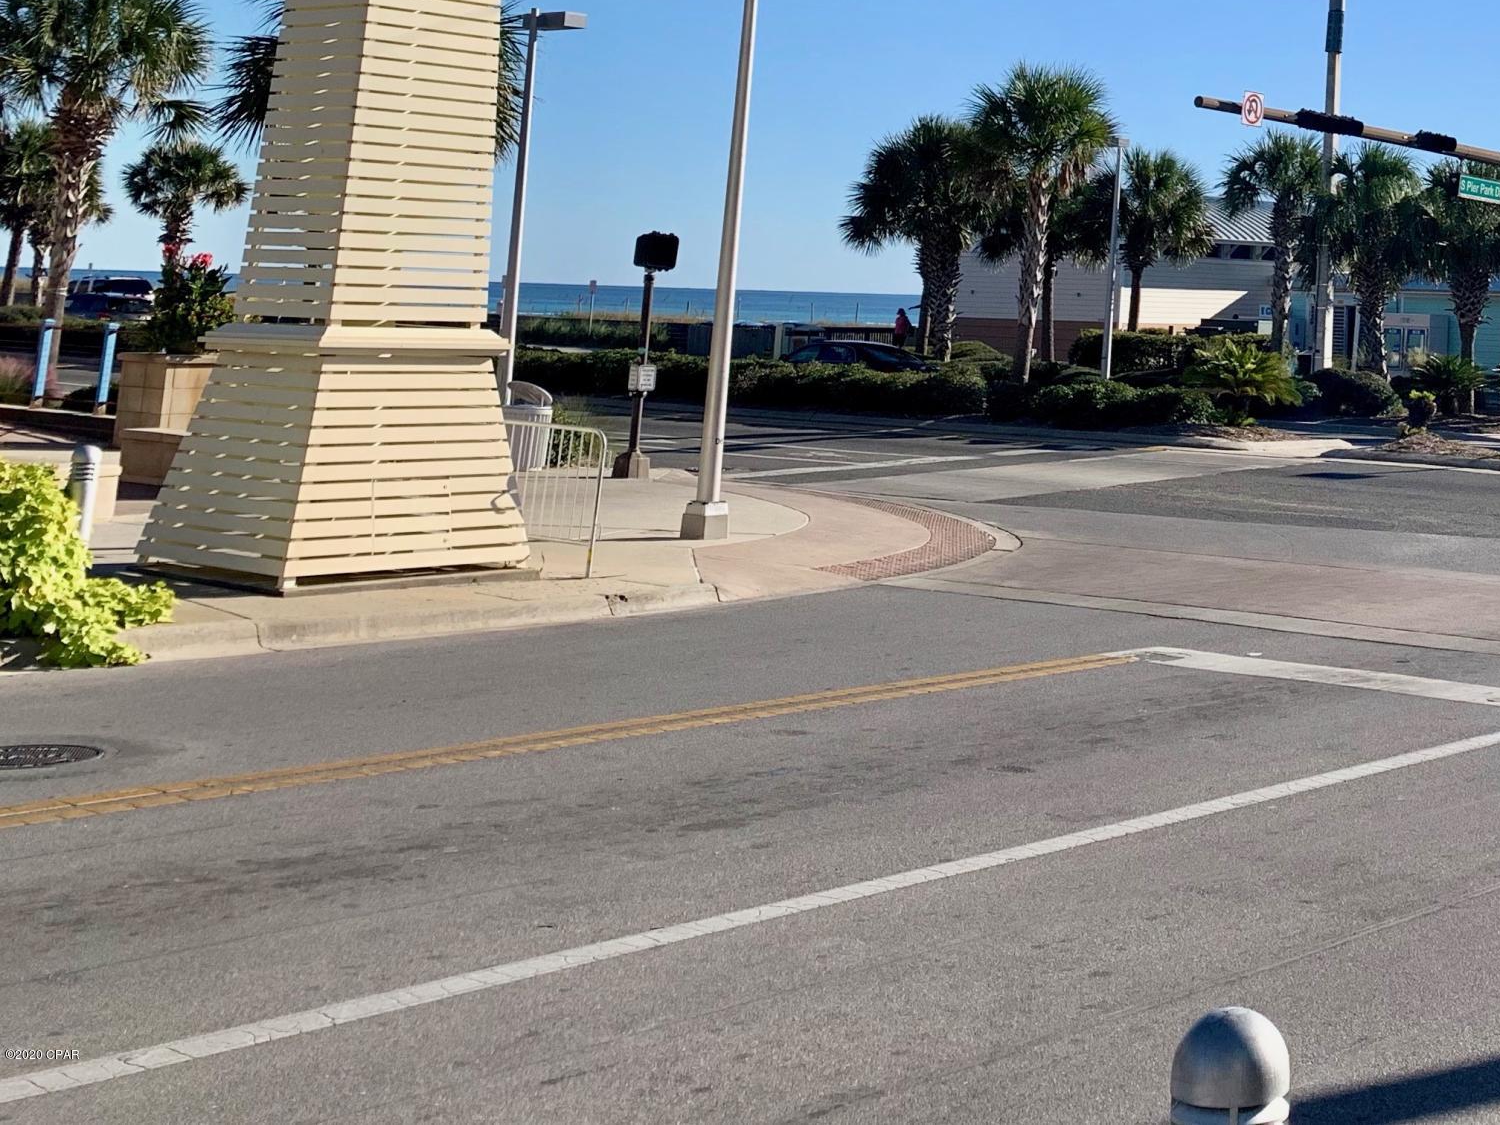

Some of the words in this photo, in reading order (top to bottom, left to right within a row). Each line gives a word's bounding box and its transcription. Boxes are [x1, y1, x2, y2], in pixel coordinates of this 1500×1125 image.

[1460, 179, 1466, 191] S
[1466, 180, 1480, 194] Pier
[1480, 183, 1494, 197] Park
